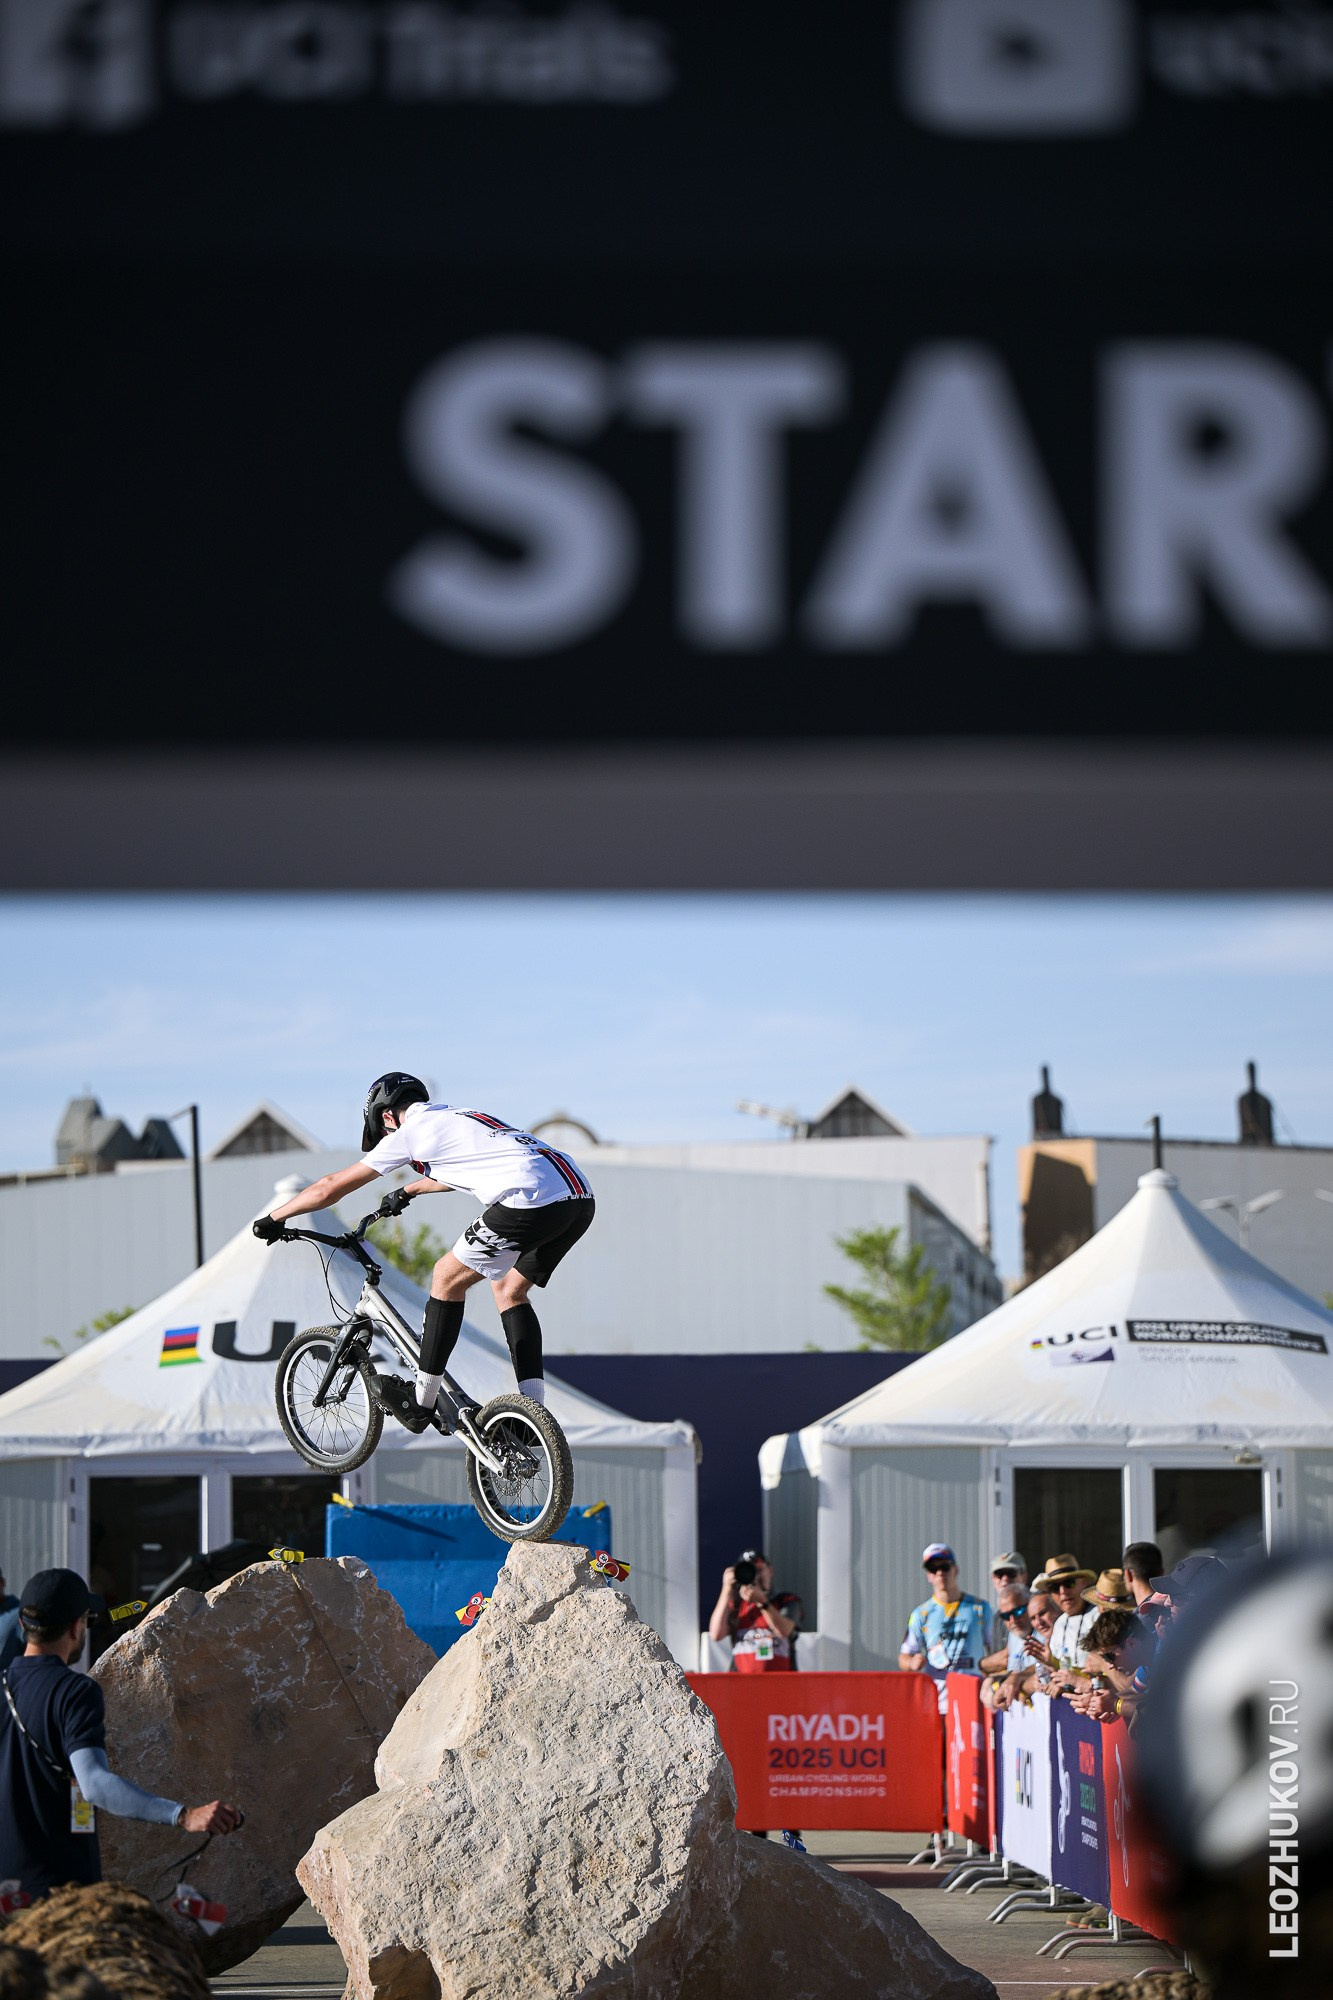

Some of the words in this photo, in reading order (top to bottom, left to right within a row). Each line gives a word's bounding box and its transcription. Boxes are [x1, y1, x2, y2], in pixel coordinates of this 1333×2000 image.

[398, 338, 1333, 654] STAR
[1047, 1325, 1118, 1347] UCI
[768, 1714, 885, 1741] RIYADH
[769, 1747, 833, 1768] 2025
[839, 1747, 886, 1768] UCI
[850, 1774, 887, 1783] WORLD
[768, 1786, 887, 1798] CHAMPIONSHIPS
